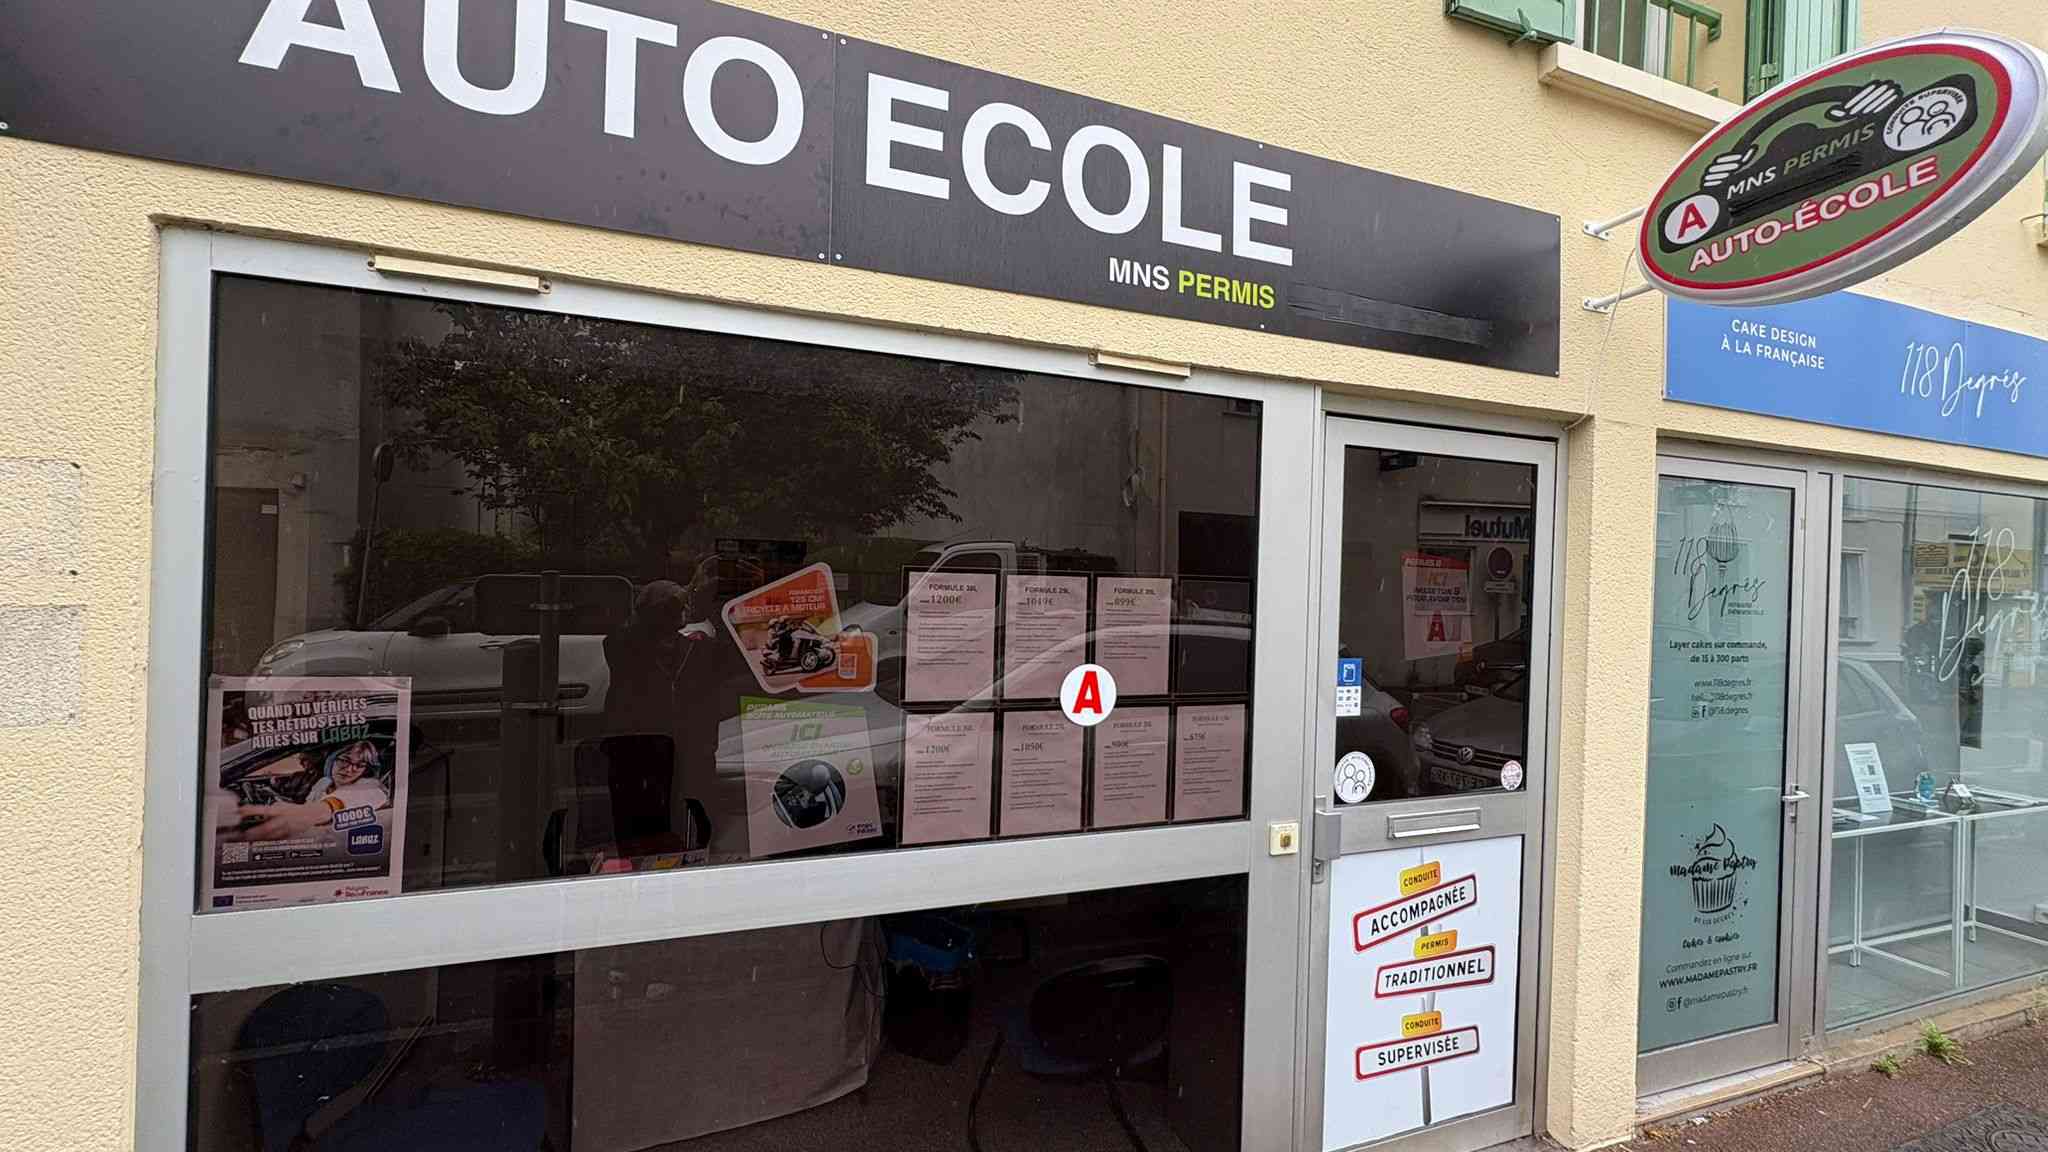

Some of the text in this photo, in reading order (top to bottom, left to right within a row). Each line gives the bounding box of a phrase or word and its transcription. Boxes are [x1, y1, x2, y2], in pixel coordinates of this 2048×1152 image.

[238, 0, 1293, 266] AUTO ECOLE
[1727, 121, 1876, 201] MNS PERMIS
[1677, 202, 1708, 239] A
[1688, 154, 1940, 272] AUTO-ÉCOLE
[1108, 256, 1275, 309] MNS PERMIS
[1731, 319, 1817, 349] CAKE DESIGN
[1721, 333, 1825, 370] À LA FRANÇAISE
[1900, 341, 2028, 418] 118 Degrés
[1674, 536, 1708, 576] 118
[1669, 640, 1690, 651] Layer
[1691, 640, 1712, 649] cakes
[1714, 641, 1725, 649] sur
[1690, 654, 1700, 663] de
[1702, 654, 1709, 663] 15
[1716, 654, 1730, 663] 300
[1731, 654, 1749, 664] parts
[1072, 671, 1103, 714] A
[247, 703, 292, 720] QUAND
[294, 702, 311, 716] TU
[251, 719, 274, 734] TES
[344, 712, 366, 725] TES
[291, 731, 318, 746] SUR
[1403, 868, 1439, 888] CONDUITE
[1370, 886, 1467, 936] ACCOMPAGNÉE
[1420, 937, 1449, 950] PERMIS
[1385, 958, 1486, 988] TRADITIONNEL
[1405, 1017, 1439, 1031] CONDUITE
[1378, 1035, 1460, 1066] SUPERVISÉE
